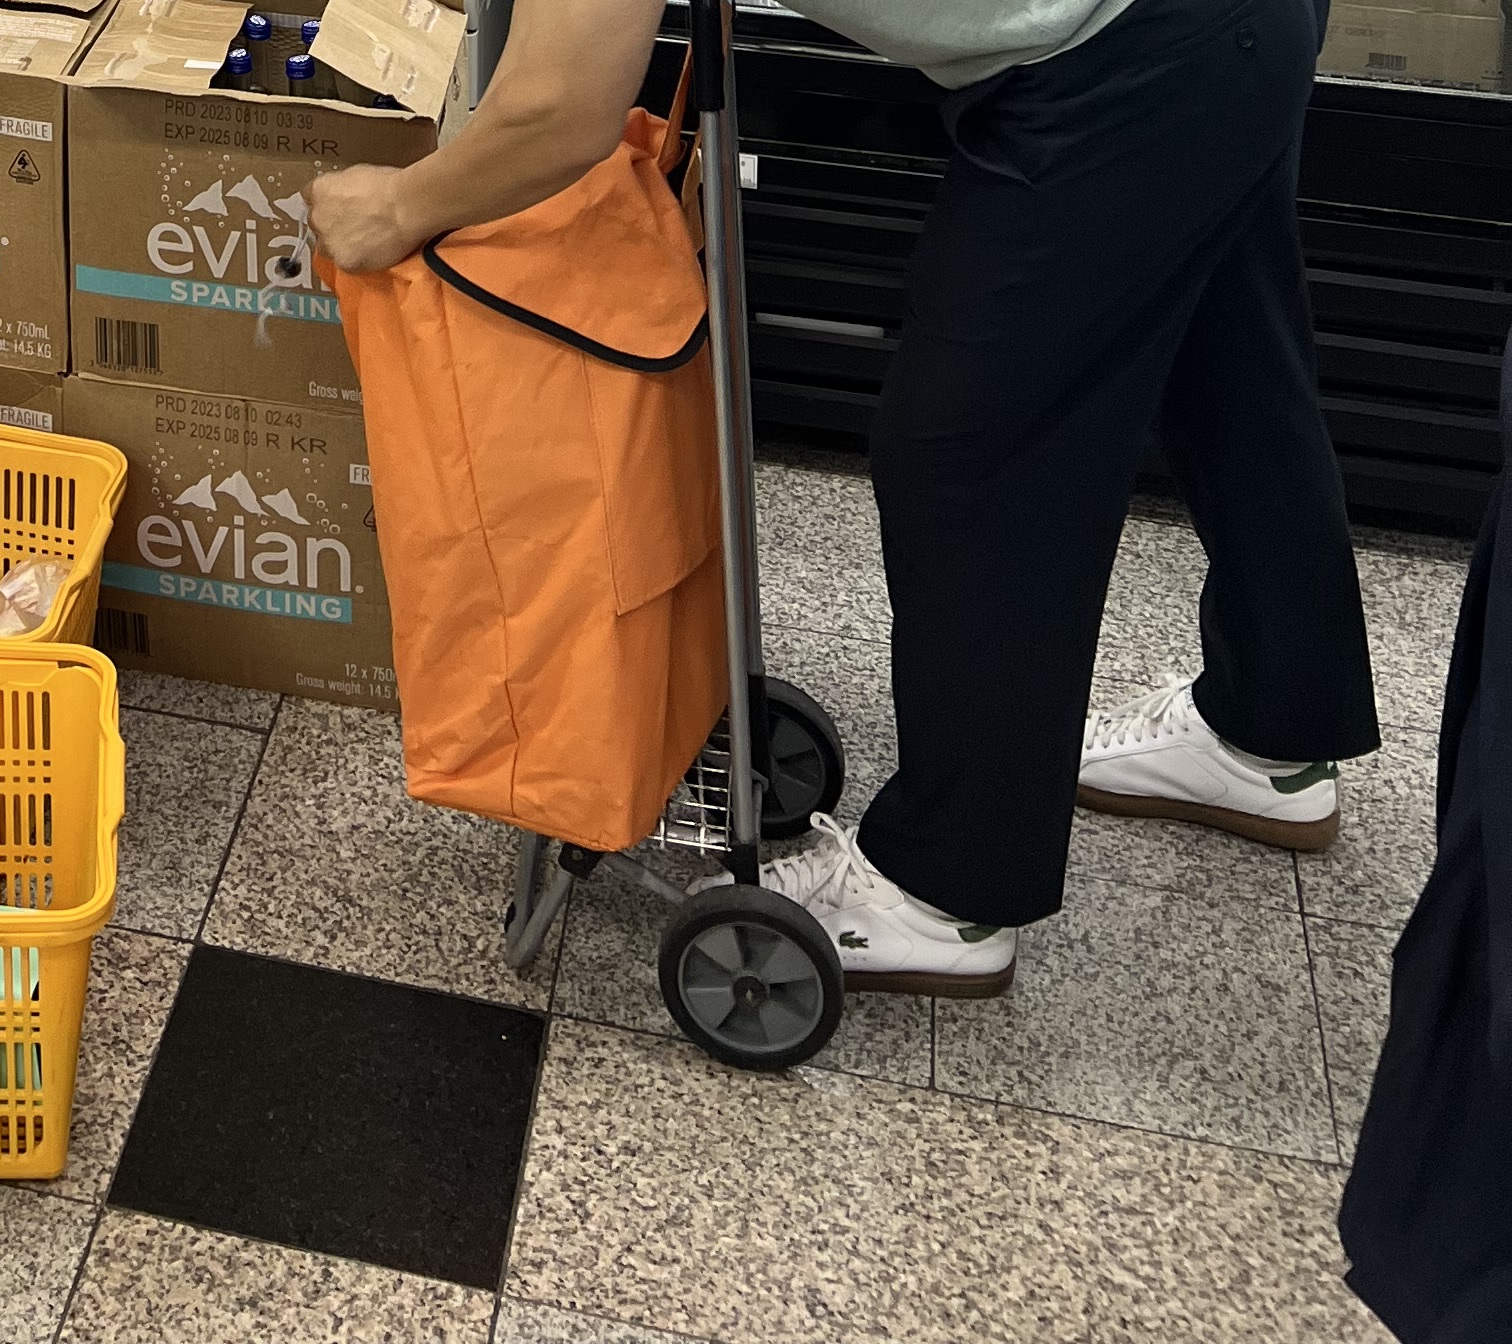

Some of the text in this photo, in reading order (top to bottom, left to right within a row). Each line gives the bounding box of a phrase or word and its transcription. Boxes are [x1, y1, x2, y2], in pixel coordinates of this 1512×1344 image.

[165, 98, 196, 118] PRD
[199, 103, 232, 122] 2023
[235, 107, 251, 124] 08
[254, 109, 268, 126] 10
[164, 122, 340, 156] EXP 2025 08 09 R KR
[146, 219, 332, 292] evia
[170, 279, 342, 322] SPARKLIN
[5, 321, 13, 334] x
[16, 319, 51, 339] 750mL
[12, 338, 35, 356] 14.5
[37, 341, 52, 358] KG
[308, 380, 338, 399] Gross
[0, 407, 50, 429] FRAGILE
[155, 394, 187, 414] PRD
[190, 399, 222, 419] 2023
[225, 402, 241, 420] 08
[243, 405, 258, 423] 10
[155, 417, 328, 455] EXP 2025 08 09 R KR
[159, 574, 343, 620] SPARKLING
[344, 663, 357, 678] 12
[360, 668, 368, 679] x
[295, 672, 325, 689] Gross
[368, 683, 392, 699] 14.5
